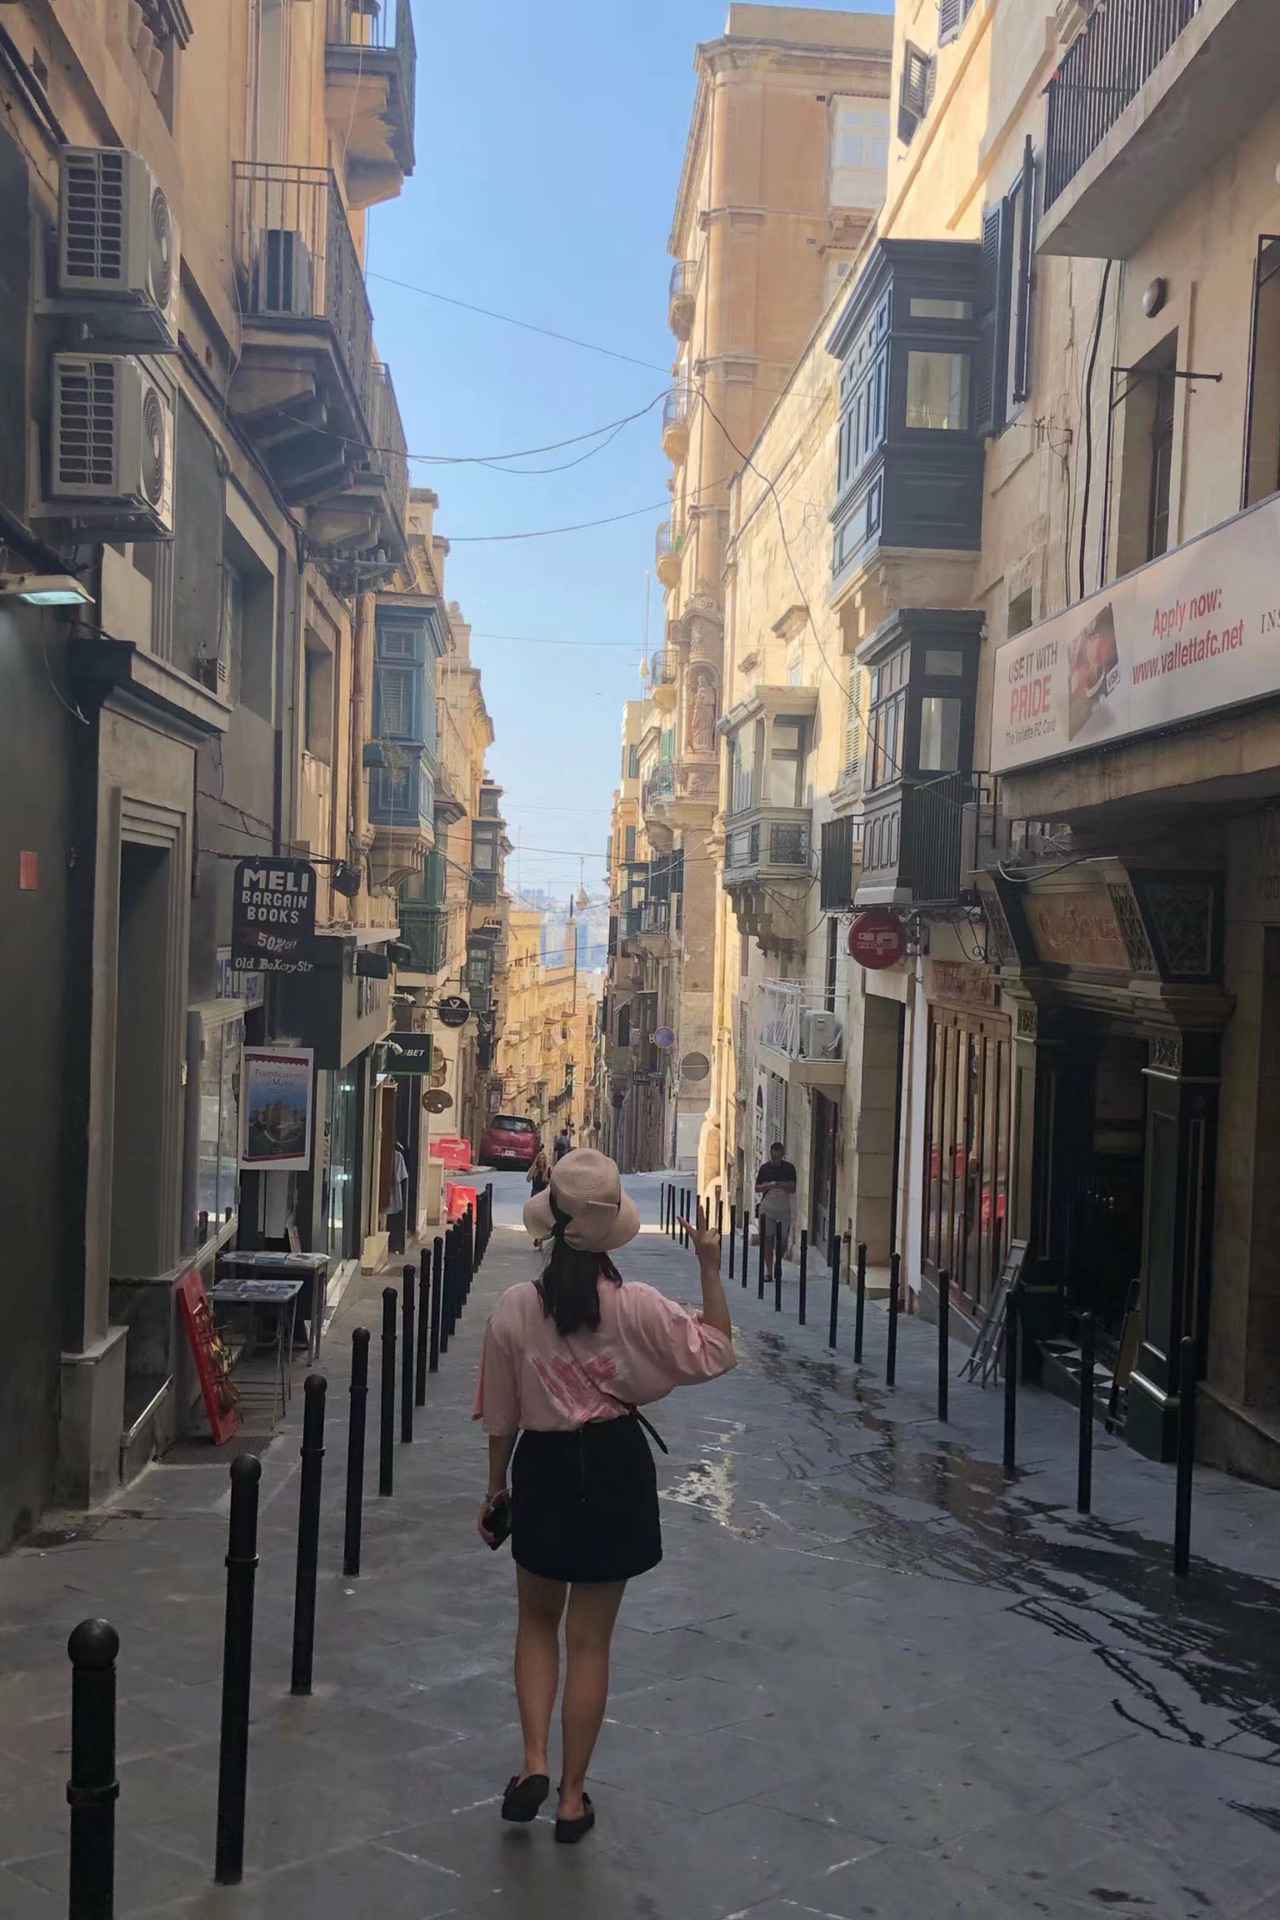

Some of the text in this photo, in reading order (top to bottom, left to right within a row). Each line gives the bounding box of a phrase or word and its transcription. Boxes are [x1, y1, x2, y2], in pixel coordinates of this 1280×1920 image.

[1152, 588, 1223, 640] Apply now:
[1008, 640, 1058, 684] USE IT WITH
[1131, 618, 1246, 685] www.vallettafc.net
[1009, 674, 1052, 726] PRIDE
[243, 868, 309, 893] MELI
[242, 890, 308, 909] BARGAIN
[247, 907, 300, 924] BOOKS
[235, 957, 254, 969] Old
